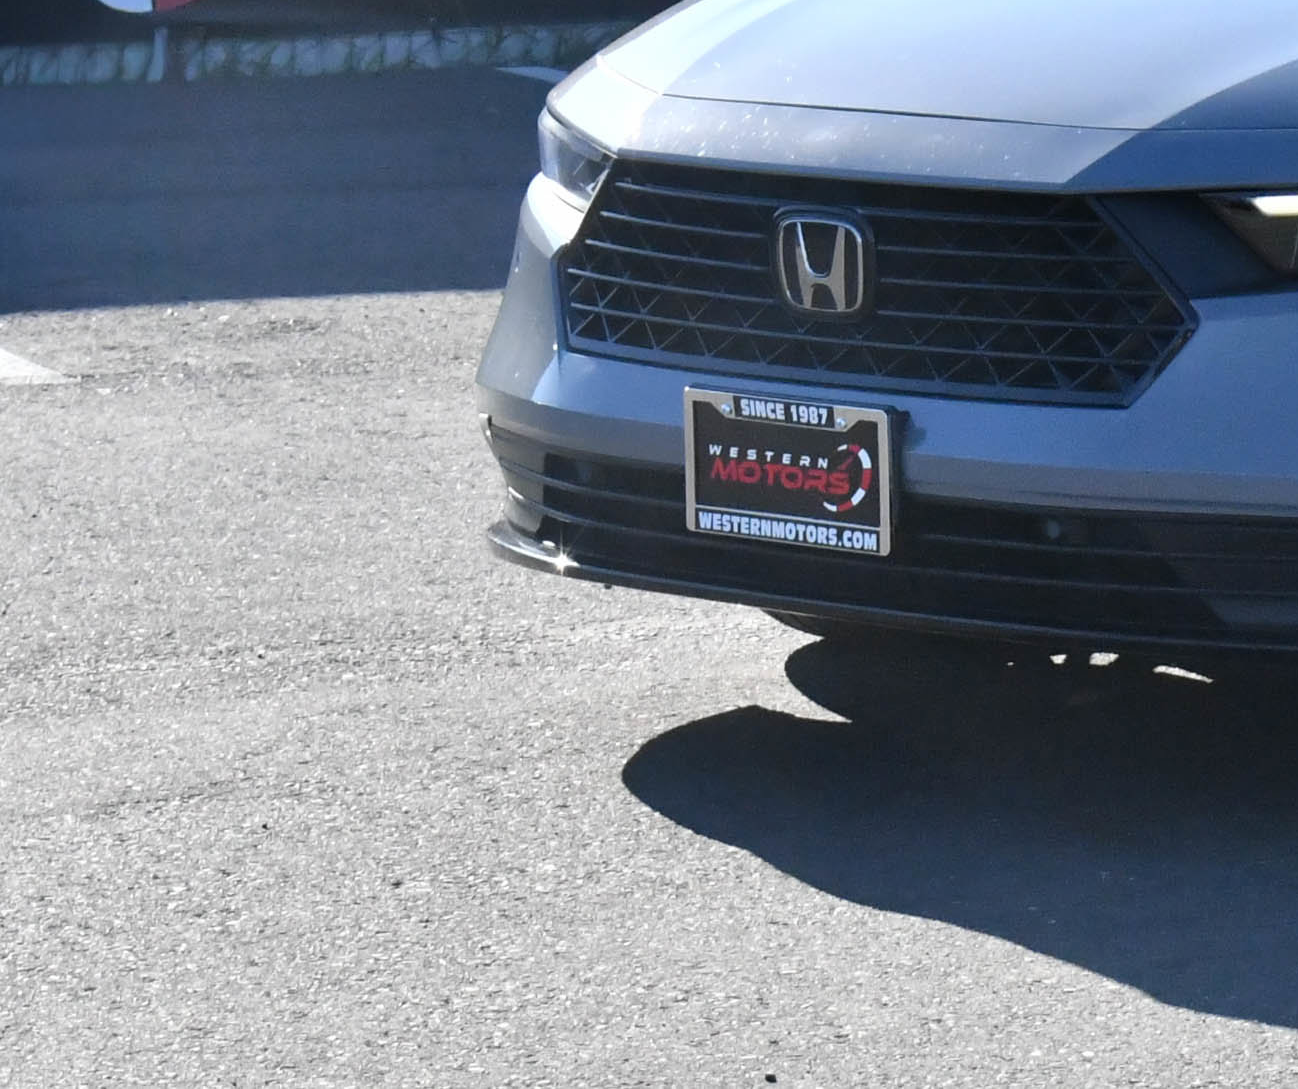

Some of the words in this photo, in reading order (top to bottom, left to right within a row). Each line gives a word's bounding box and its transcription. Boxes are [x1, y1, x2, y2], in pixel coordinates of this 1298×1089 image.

[740, 398, 785, 421] SINCE
[790, 405, 828, 425] 1987
[708, 443, 829, 470] WESTERN
[710, 457, 850, 496] MOTORS
[698, 511, 878, 551] WESTERNMOTORS.COM
